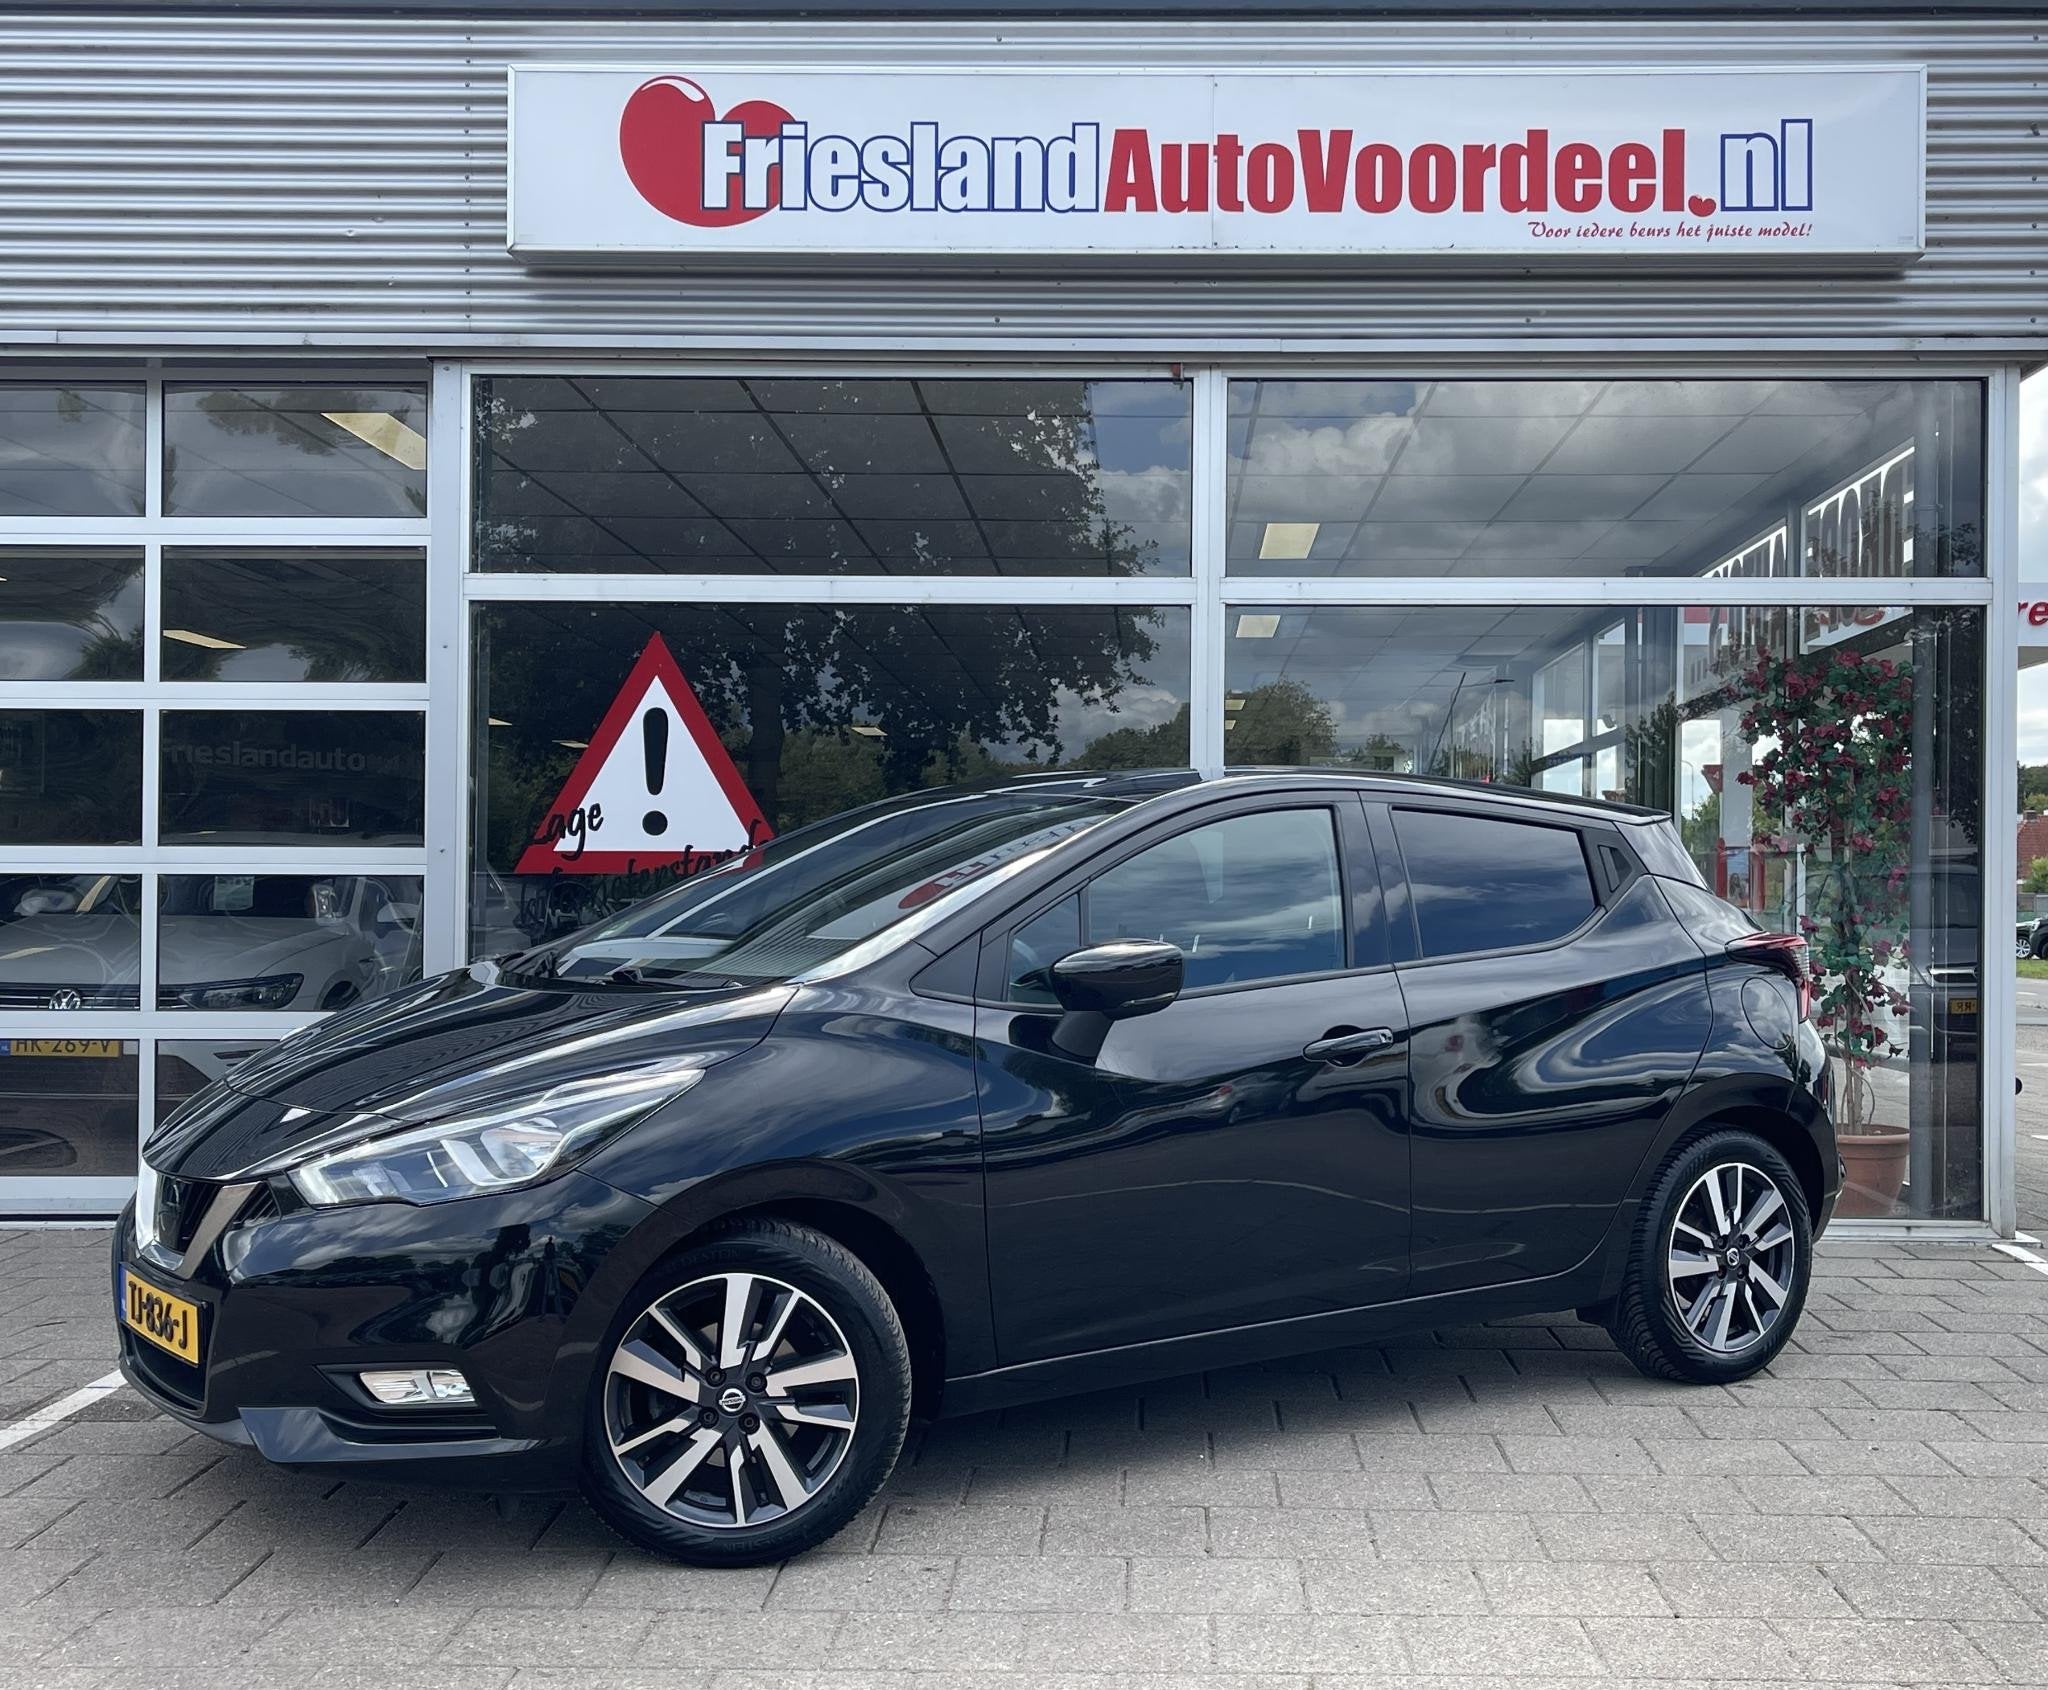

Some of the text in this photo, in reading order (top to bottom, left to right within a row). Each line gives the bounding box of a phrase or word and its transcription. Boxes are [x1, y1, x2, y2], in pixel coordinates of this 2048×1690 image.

[1528, 221, 1813, 242] Voor iedere beurs het juiste model!
[128, 1280, 188, 1349] TJ-836-J
